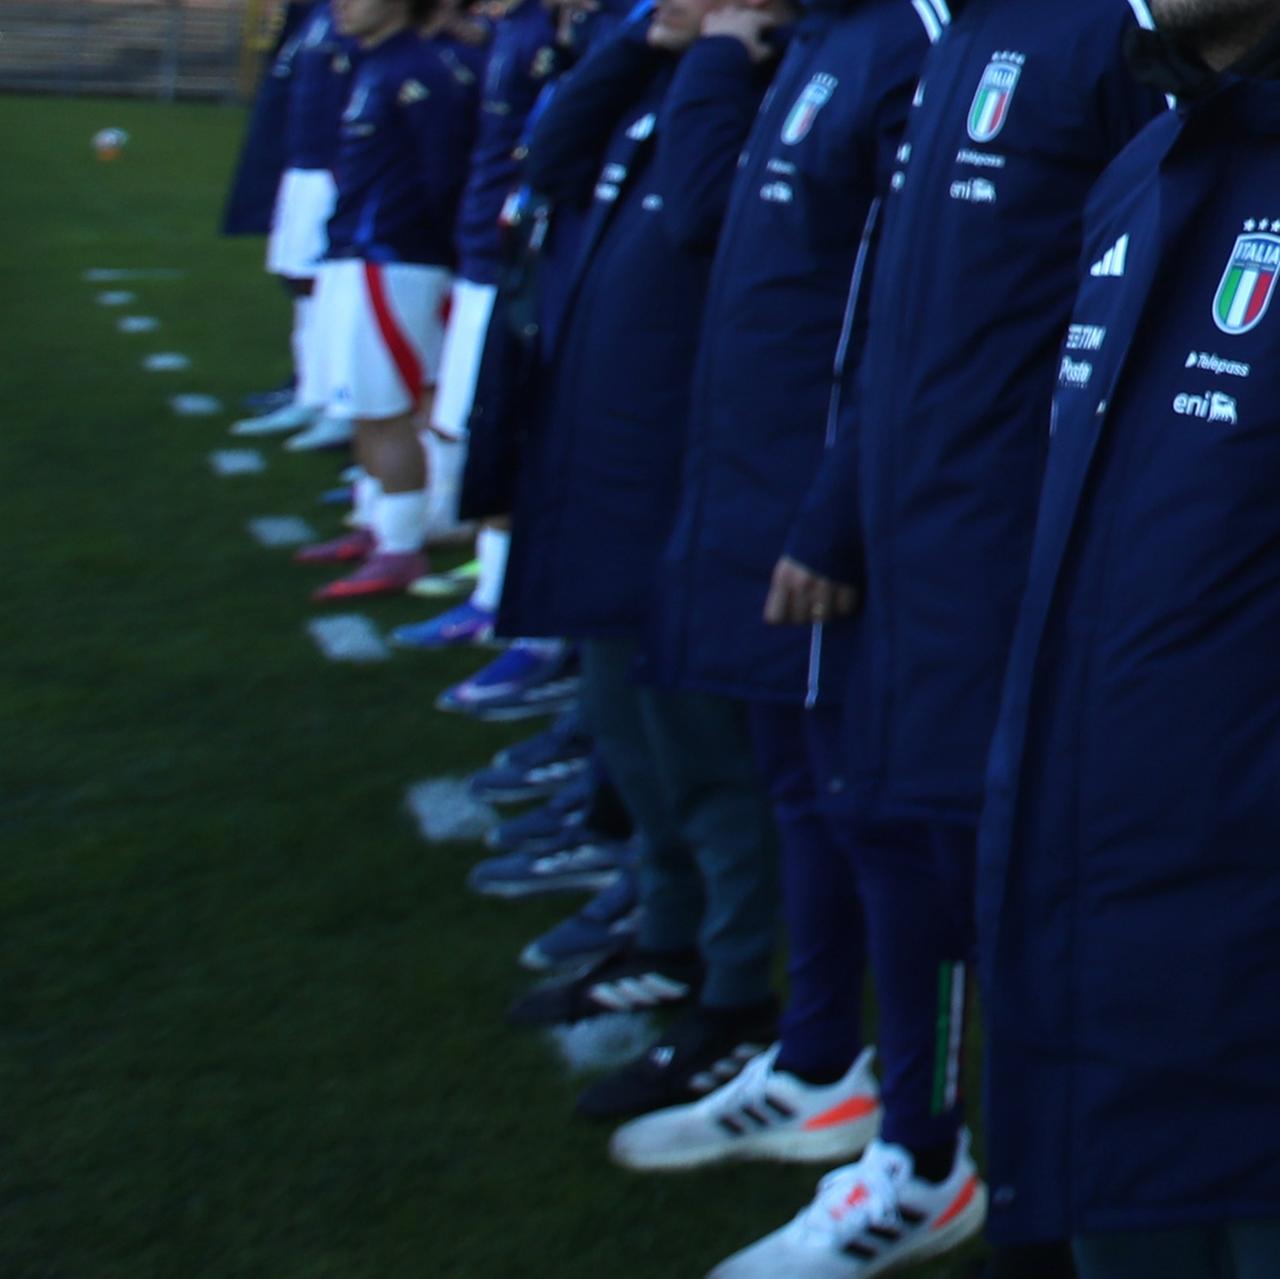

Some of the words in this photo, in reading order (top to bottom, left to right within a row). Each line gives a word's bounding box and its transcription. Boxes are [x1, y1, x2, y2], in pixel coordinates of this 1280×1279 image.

[1235, 241, 1280, 265] ITALIA
[1197, 352, 1250, 377] Telepass
[1173, 390, 1212, 418] eni
